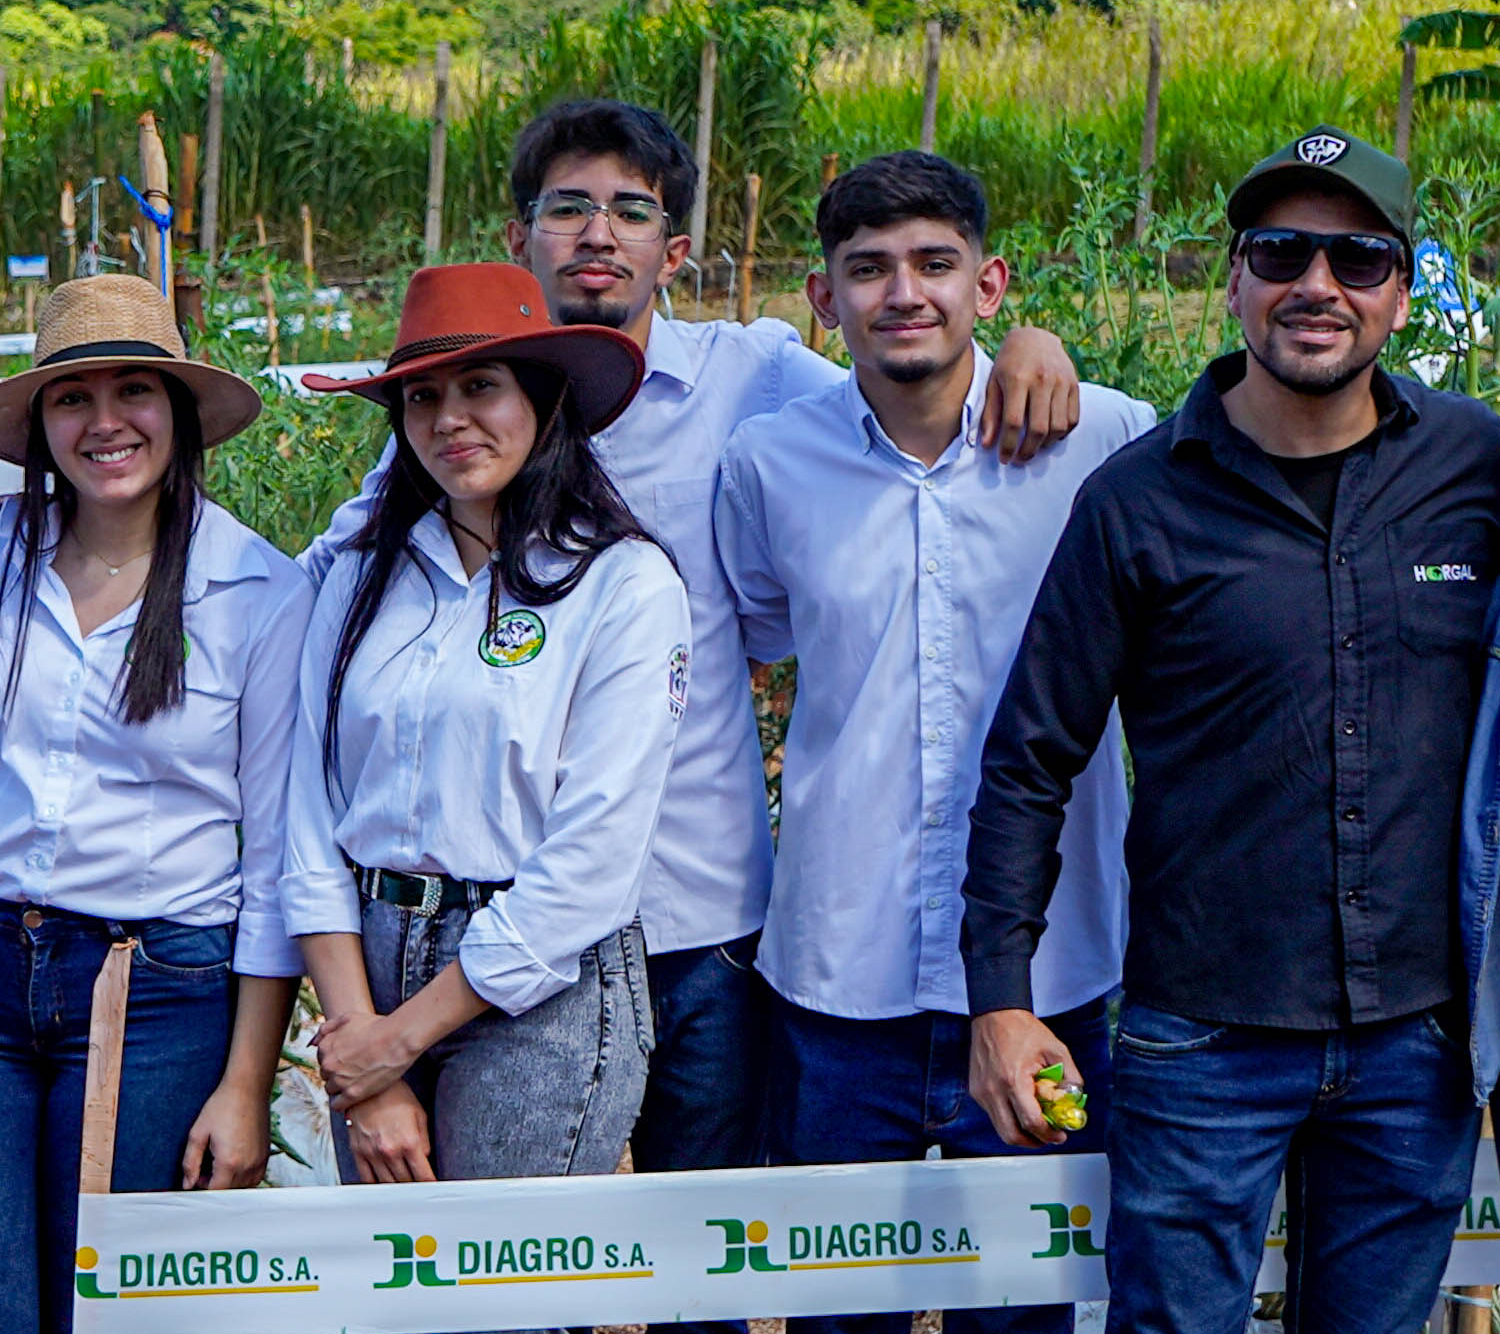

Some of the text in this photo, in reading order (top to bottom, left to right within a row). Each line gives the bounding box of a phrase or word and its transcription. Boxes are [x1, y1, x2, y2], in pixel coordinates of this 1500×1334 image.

[458, 1235, 654, 1275] DIAGRO S.A.
[790, 1220, 980, 1260] DIAGRO S.A.
[119, 1249, 319, 1288] DIAGRO S.A.
